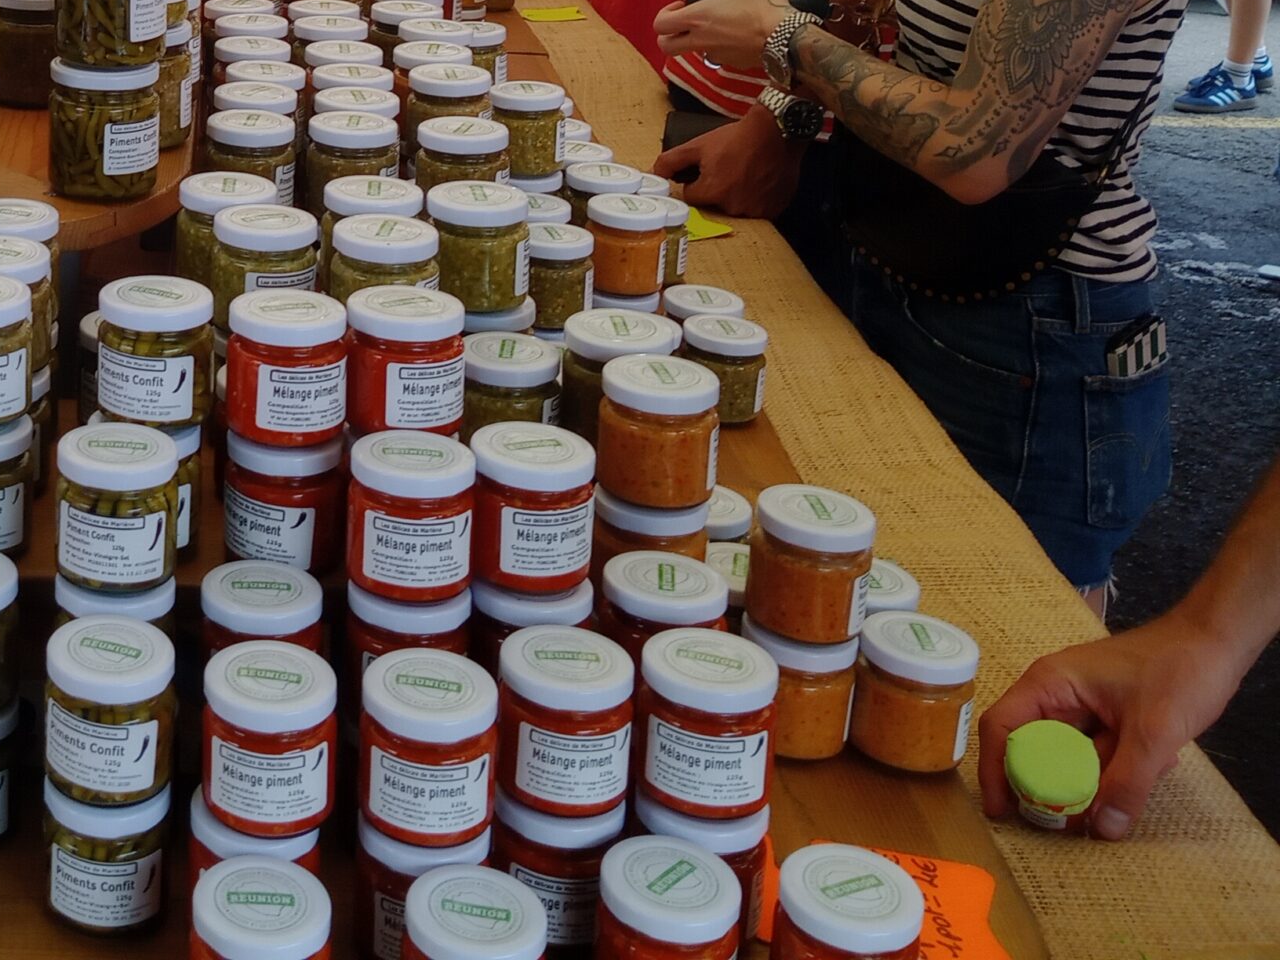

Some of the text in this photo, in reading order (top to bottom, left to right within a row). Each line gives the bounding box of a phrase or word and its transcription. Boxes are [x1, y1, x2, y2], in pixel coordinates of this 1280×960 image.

[131, 373, 164, 388] Confit
[402, 381, 441, 397] Mélange
[273, 382, 339, 401] Mélange piment
[91, 530, 115, 542] Confit
[516, 523, 586, 543] Mélange piment
[112, 545, 125, 553] 125g
[376, 534, 453, 556] Mélange piment
[82, 638, 140, 658] REUNION
[537, 650, 599, 662] REUNION
[239, 667, 300, 682] REUNION
[398, 674, 461, 692] REUNION
[51, 720, 125, 757] Piments Confit
[532, 747, 612, 771] Mélange piment
[659, 742, 742, 773] Mélange piment
[222, 762, 303, 789] Mélange piment
[383, 773, 466, 801] Mélange piment
[56, 865, 136, 893] Piments Confit
[229, 894, 291, 905] REUNION
[445, 901, 510, 922] REUNION
